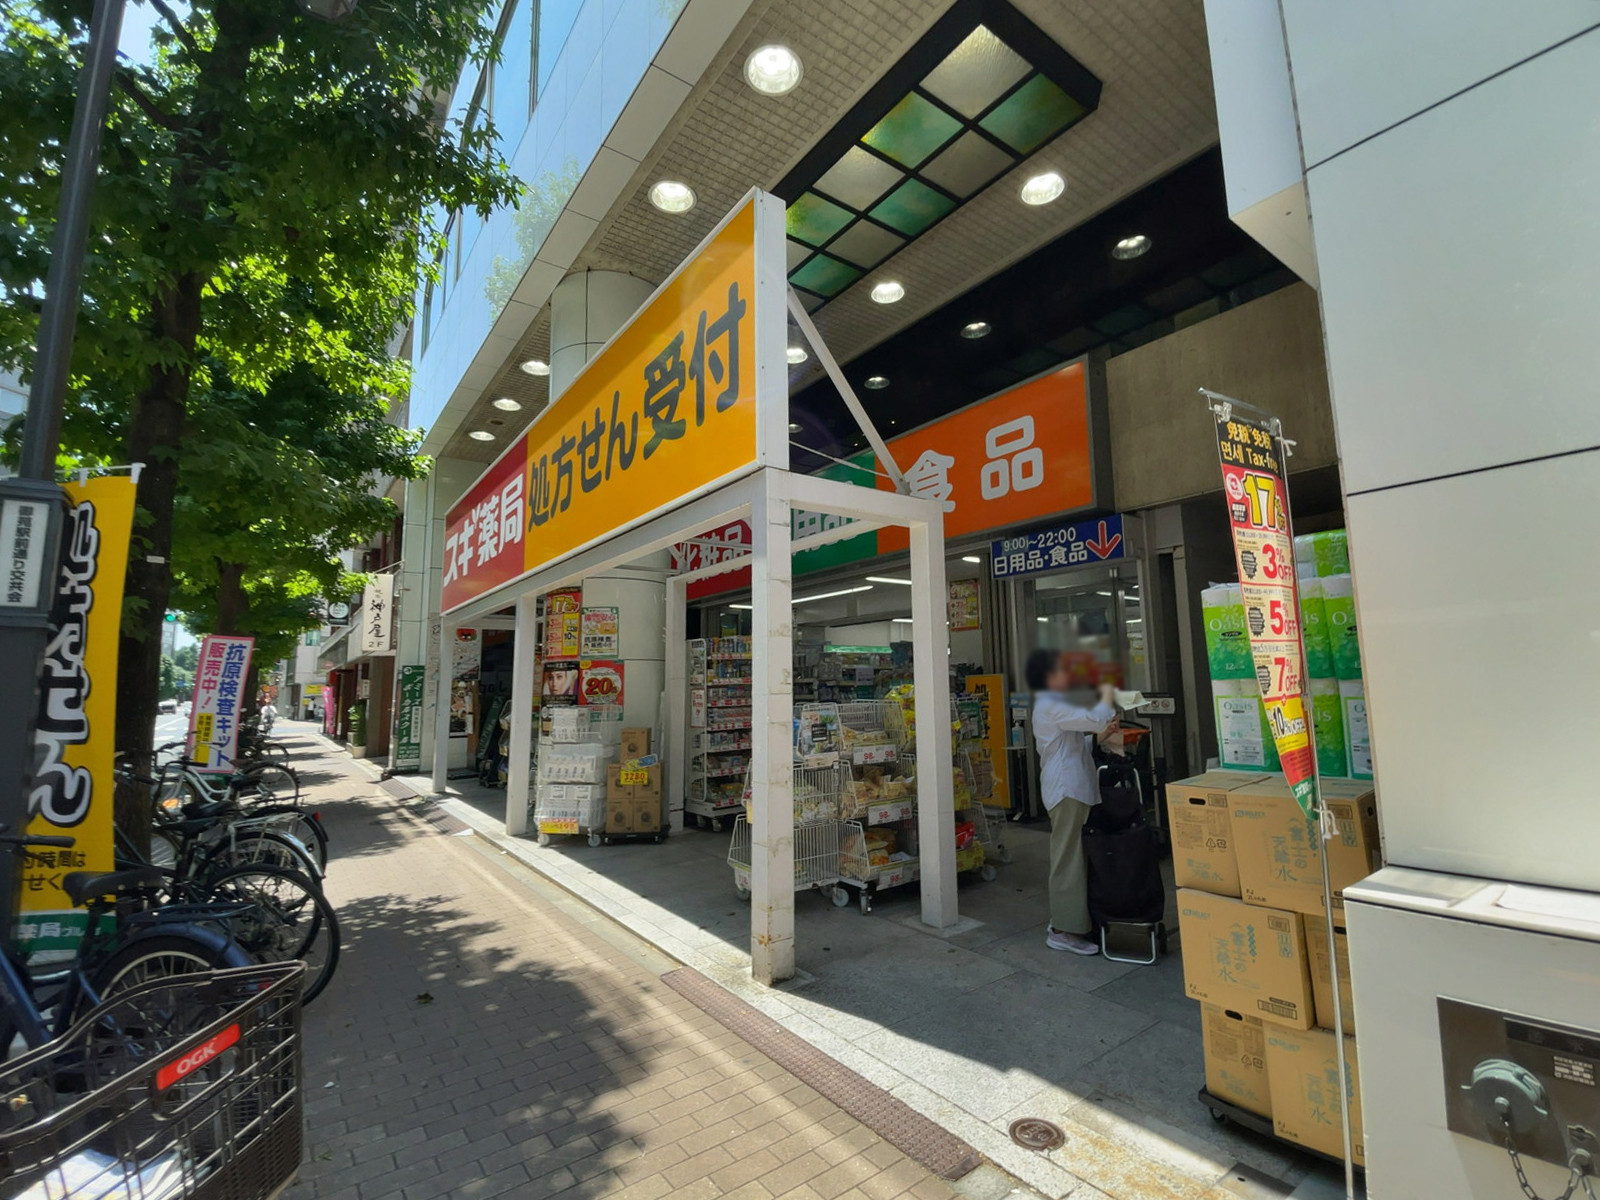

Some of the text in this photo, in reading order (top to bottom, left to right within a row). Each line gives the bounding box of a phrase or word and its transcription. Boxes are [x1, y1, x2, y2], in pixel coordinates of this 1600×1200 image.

[527, 281, 747, 532] 処方せん受付
[905, 415, 1045, 514] 食品
[443, 473, 524, 588] スギ薬局
[1210, 617, 1245, 631] Oasi
[201, 642, 227, 709] 販売中！
[215, 643, 247, 767] 抗原検査キット
[176, 1042, 216, 1074] OGK
